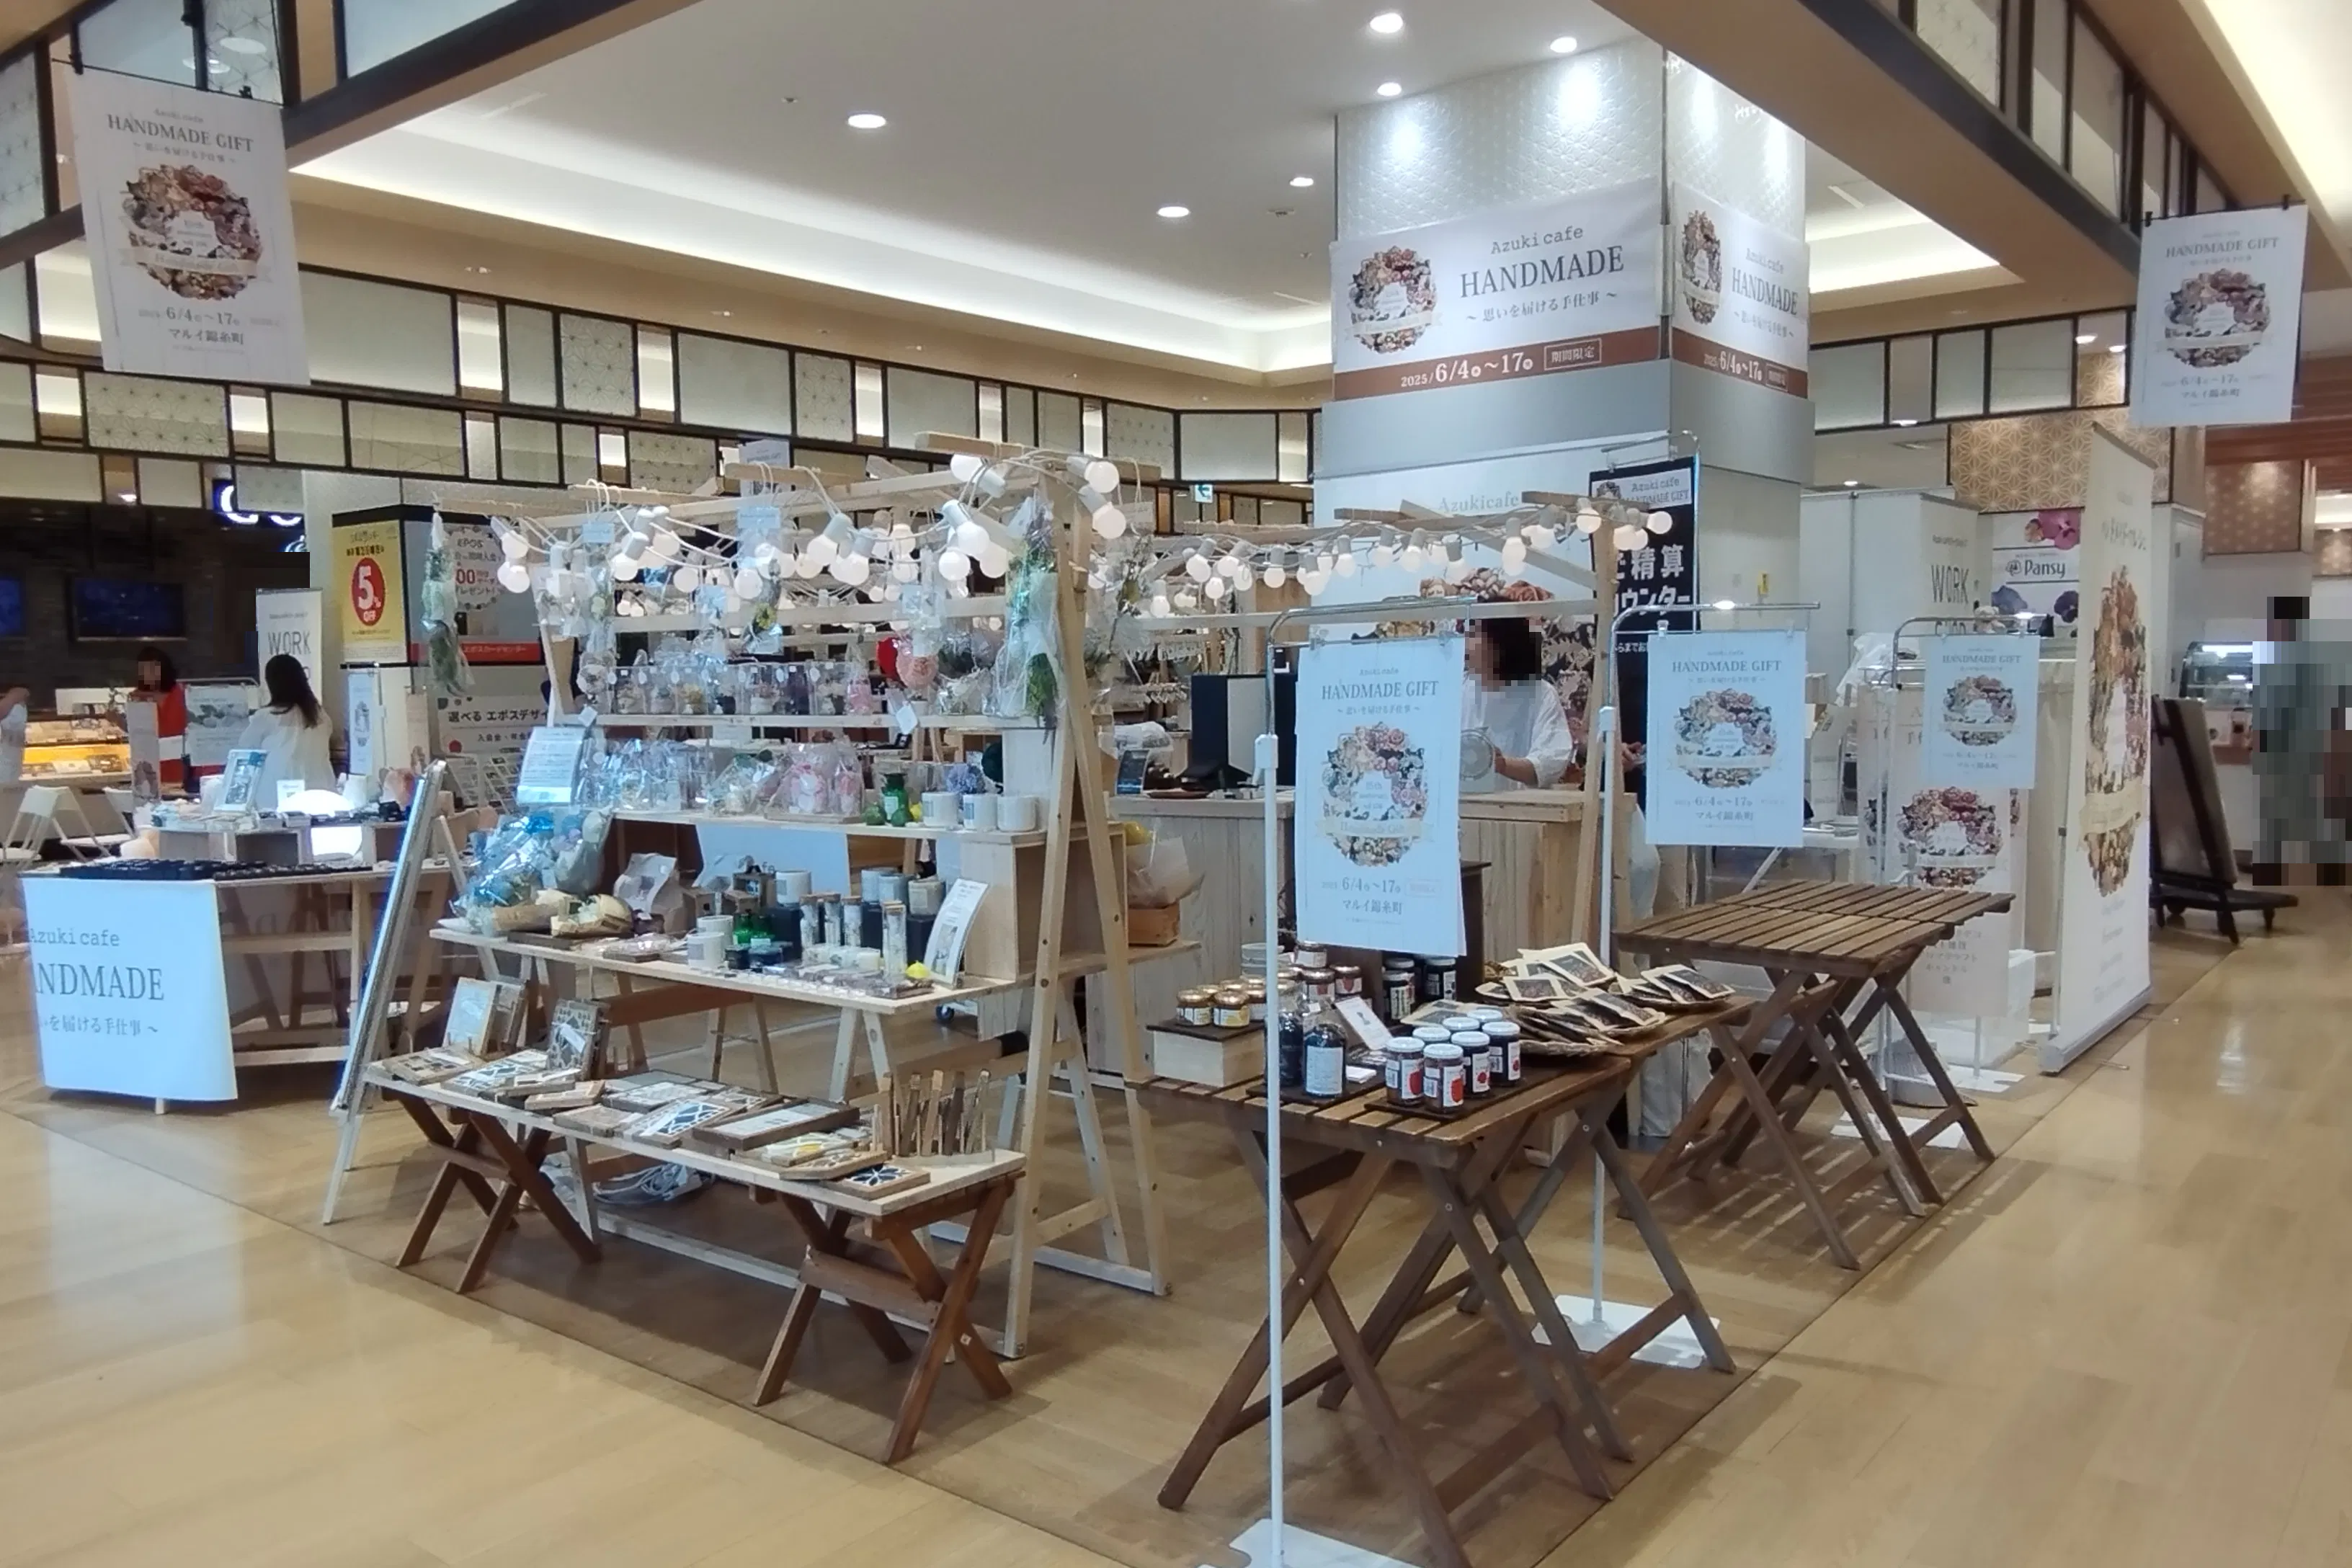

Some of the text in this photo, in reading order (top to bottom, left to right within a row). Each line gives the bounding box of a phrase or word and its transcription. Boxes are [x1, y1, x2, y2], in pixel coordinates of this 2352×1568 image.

[107, 114, 211, 145] HANDMADE
[216, 134, 254, 151] GIFT
[1491, 226, 1584, 254] Azuki cafe
[2165, 237, 2279, 258] HANDMADE GIFT
[1461, 245, 1625, 298] HANDMADE
[1732, 267, 1799, 316] HANDMADE
[2024, 559, 2066, 579] Pansy
[1930, 564, 1969, 605] WORK
[1615, 585, 1690, 616] ウンター
[267, 631, 311, 656] WORK
[1672, 660, 1782, 673] HANDMADE GIFT
[1322, 681, 1440, 700] HANDMADE GIFT
[79, 929, 120, 947] cafe
[36, 963, 164, 1001] NDMADE
